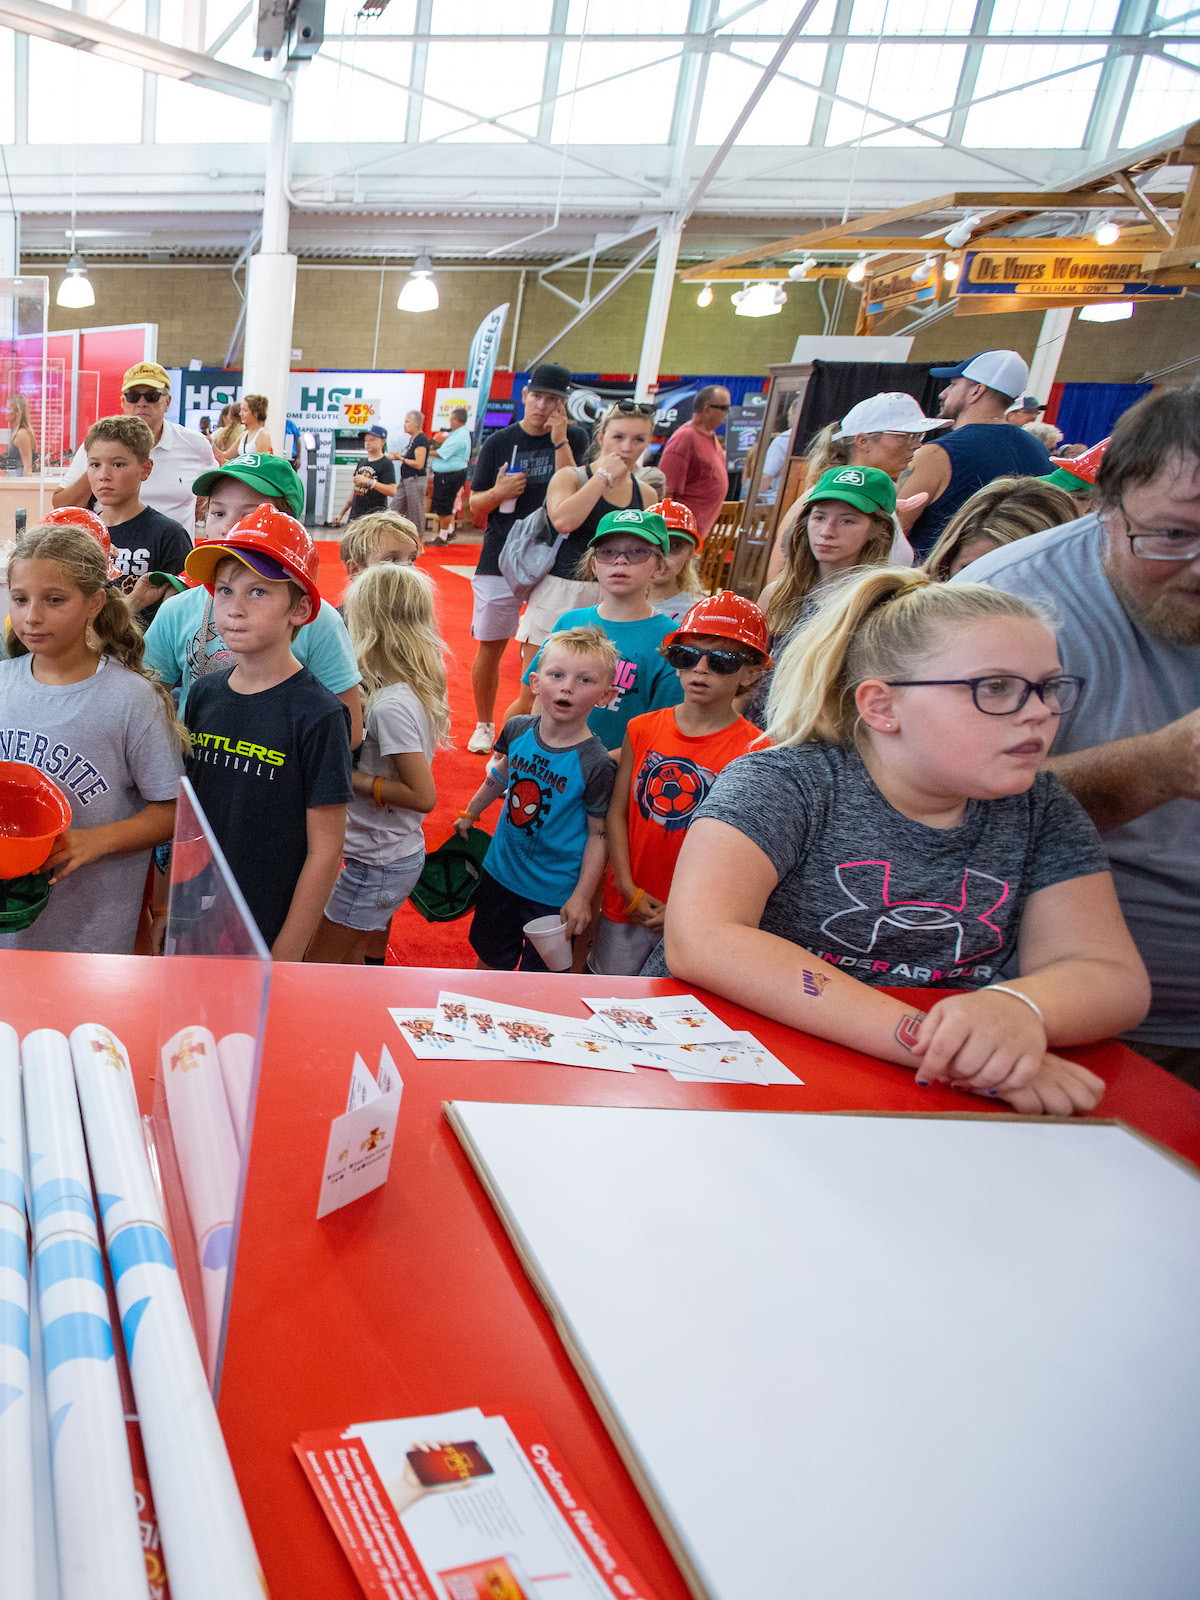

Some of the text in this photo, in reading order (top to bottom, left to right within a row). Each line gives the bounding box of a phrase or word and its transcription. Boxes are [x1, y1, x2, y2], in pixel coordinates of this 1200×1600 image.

[344, 404, 375, 416] 75%
[348, 416, 368, 425] OFF
[525, 465, 553, 477] EAVEN?
[115, 547, 151, 576] RS
[532, 753, 551, 767] THE
[509, 754, 568, 794] AMAZING
[890, 962, 993, 982] ARMOUR
[802, 968, 820, 997] UNI
[530, 1443, 576, 1509] Cyclone
